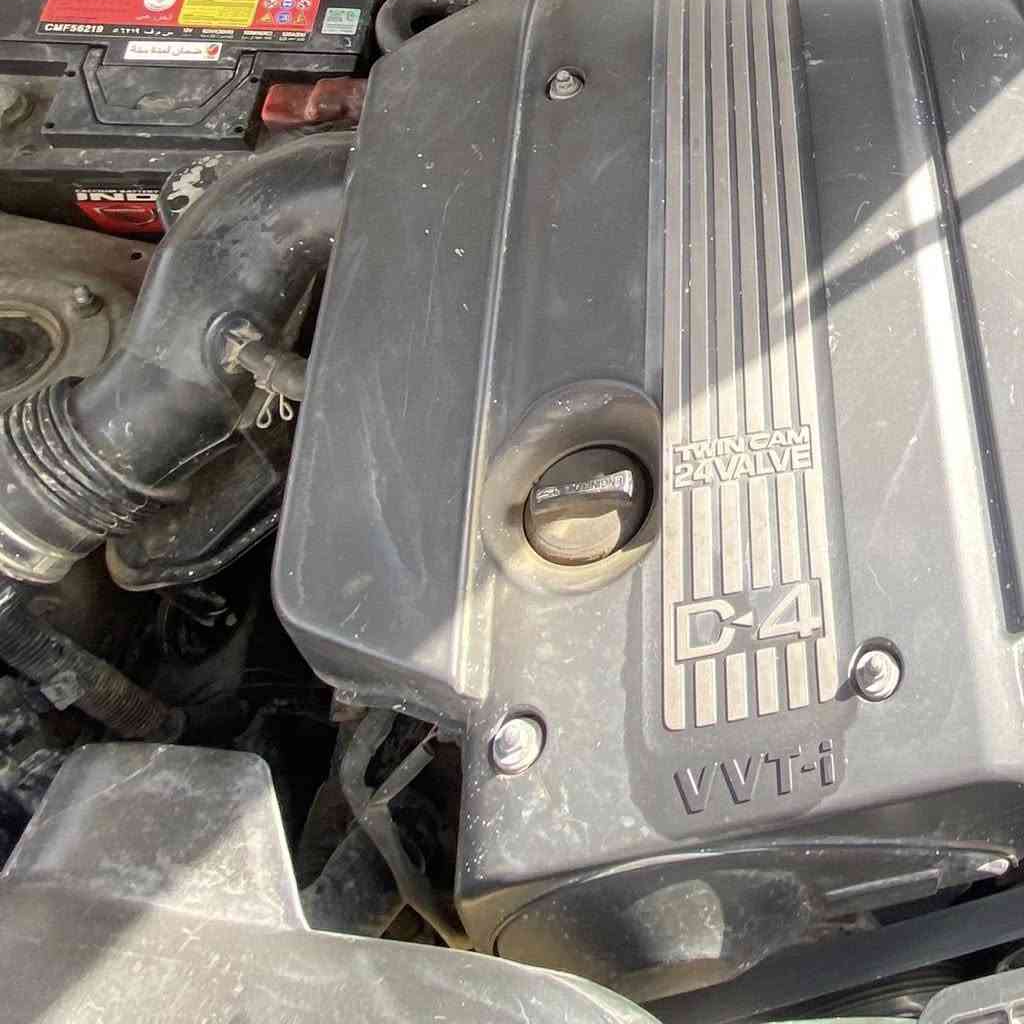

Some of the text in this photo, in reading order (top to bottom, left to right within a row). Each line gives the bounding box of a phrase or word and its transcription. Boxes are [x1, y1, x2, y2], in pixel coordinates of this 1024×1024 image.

[44, 23, 104, 33] CMF56219
[674, 425, 811, 461] TWIN CAM
[673, 739, 836, 815] VVT-i
